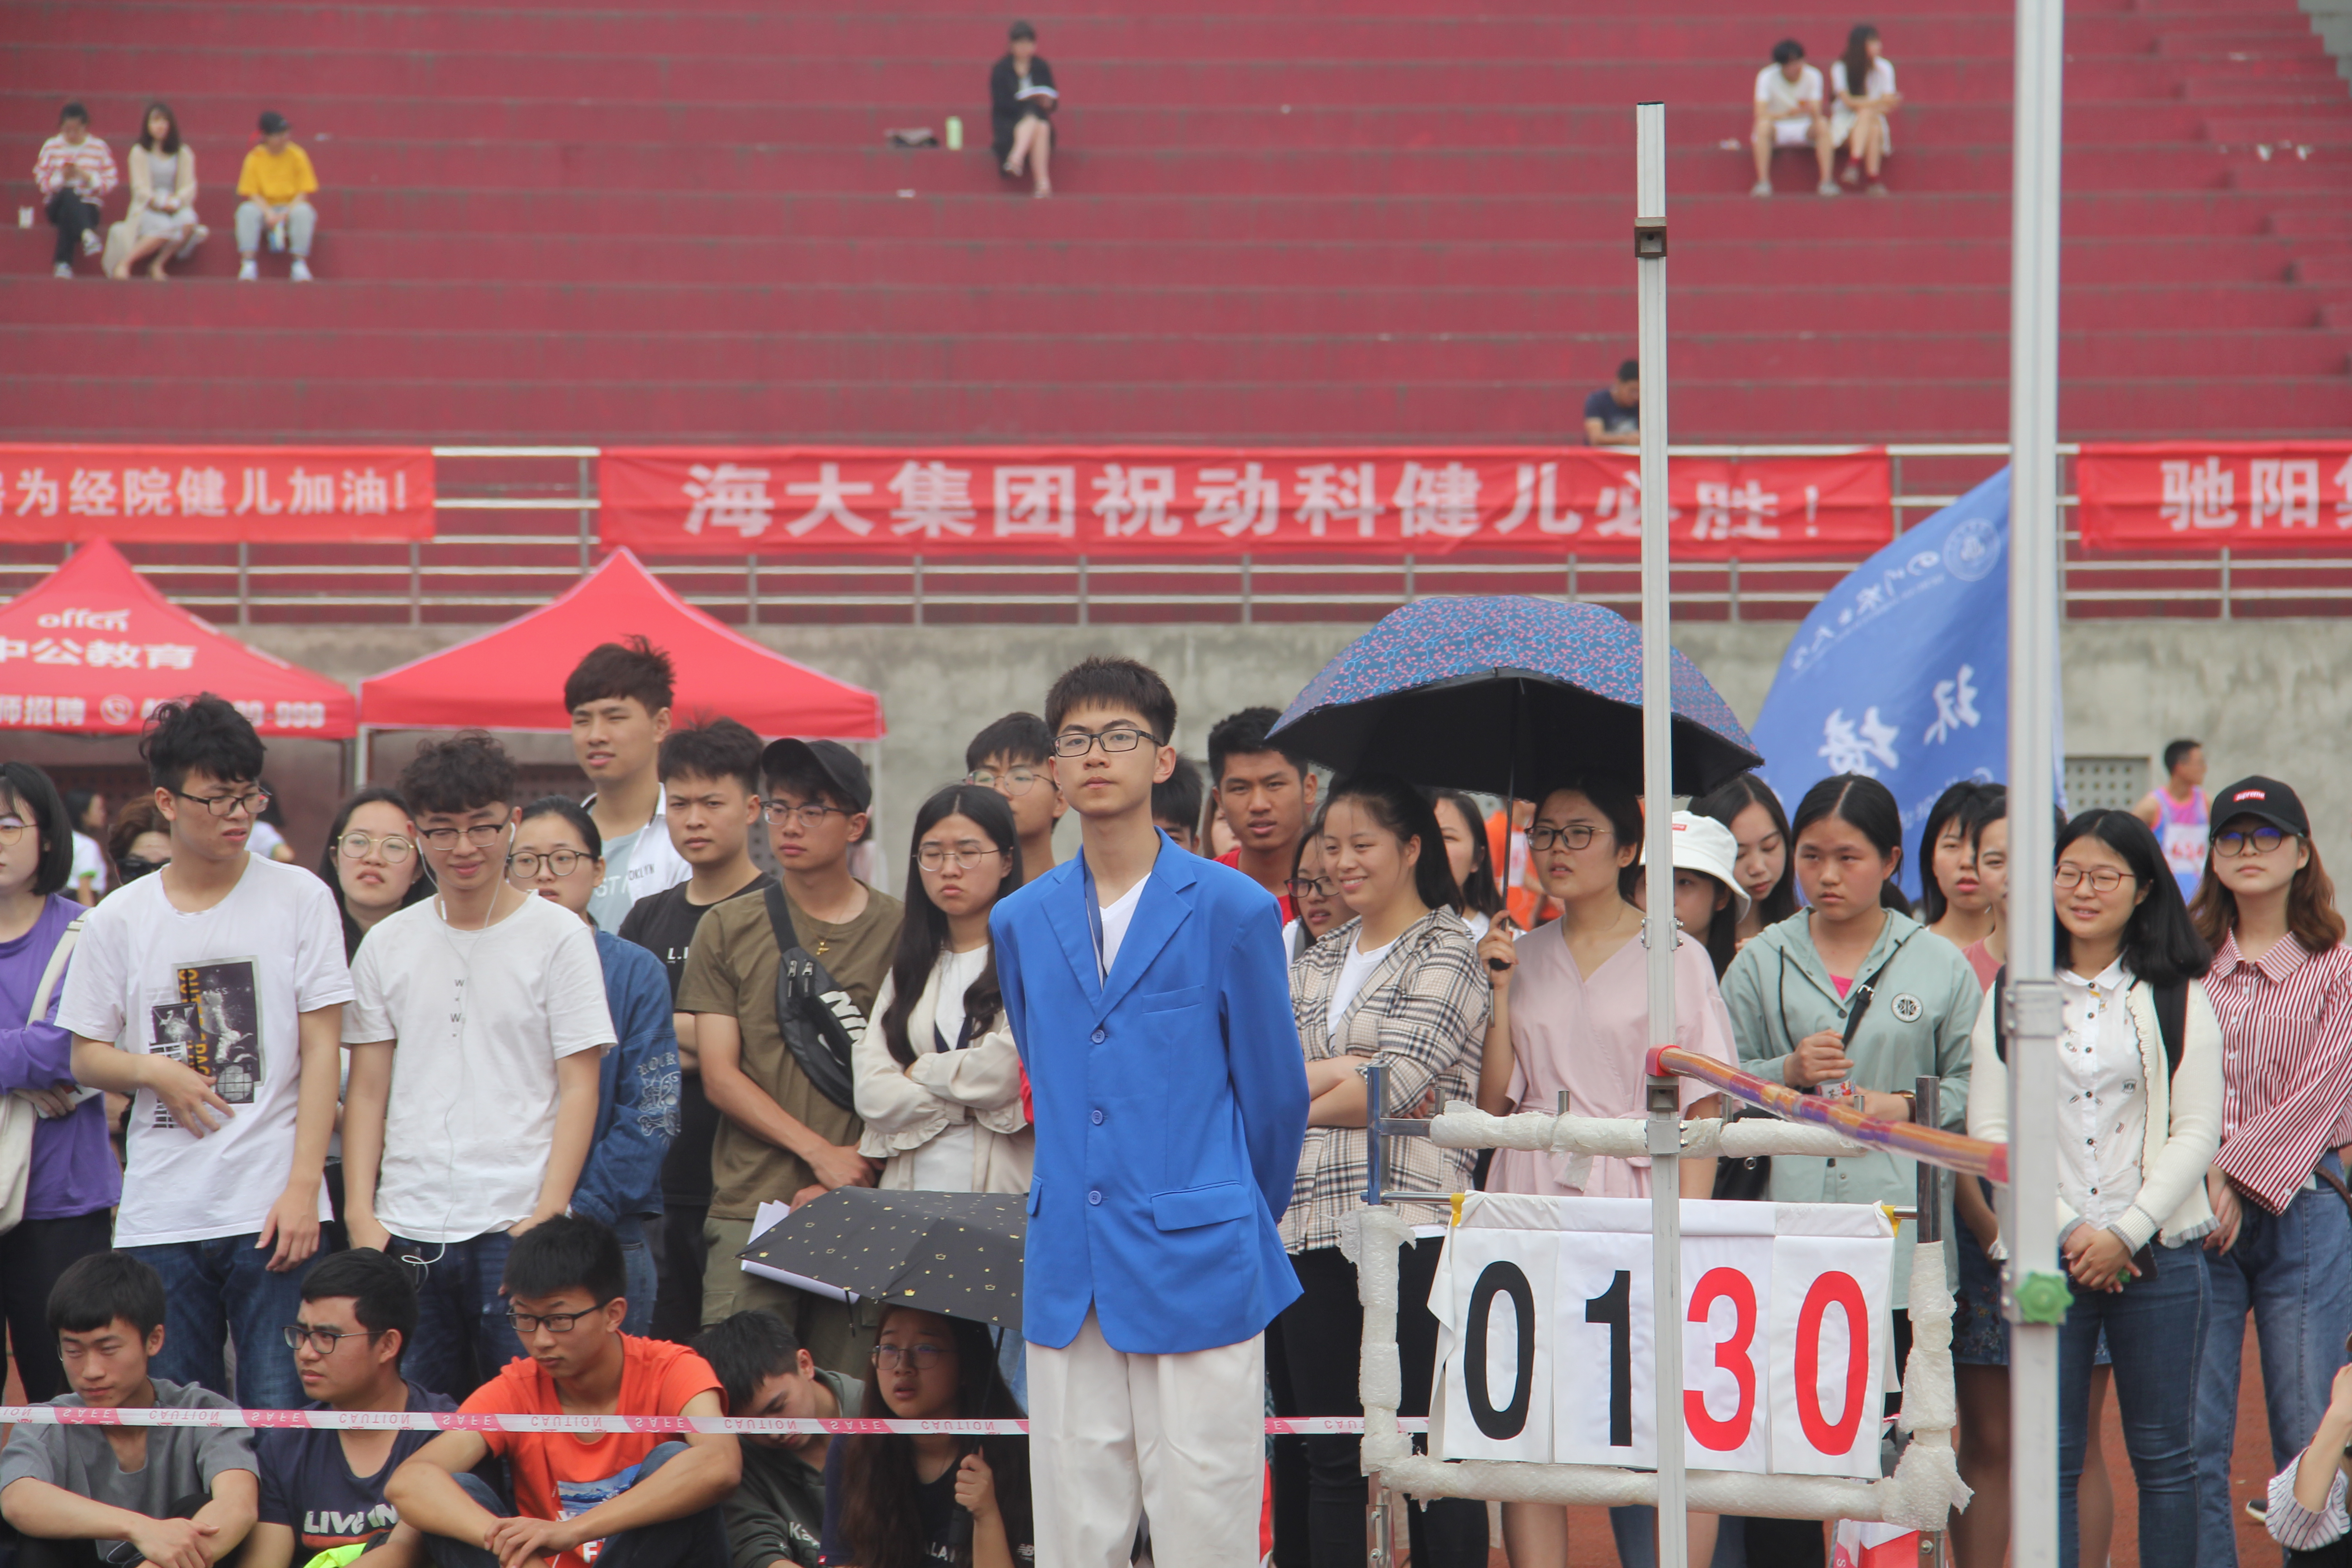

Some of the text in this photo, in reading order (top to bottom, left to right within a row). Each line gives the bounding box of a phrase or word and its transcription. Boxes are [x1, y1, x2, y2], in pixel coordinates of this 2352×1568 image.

[0, 467, 407, 516] 为经院健儿加油!
[2159, 456, 2352, 531] 驰阳
